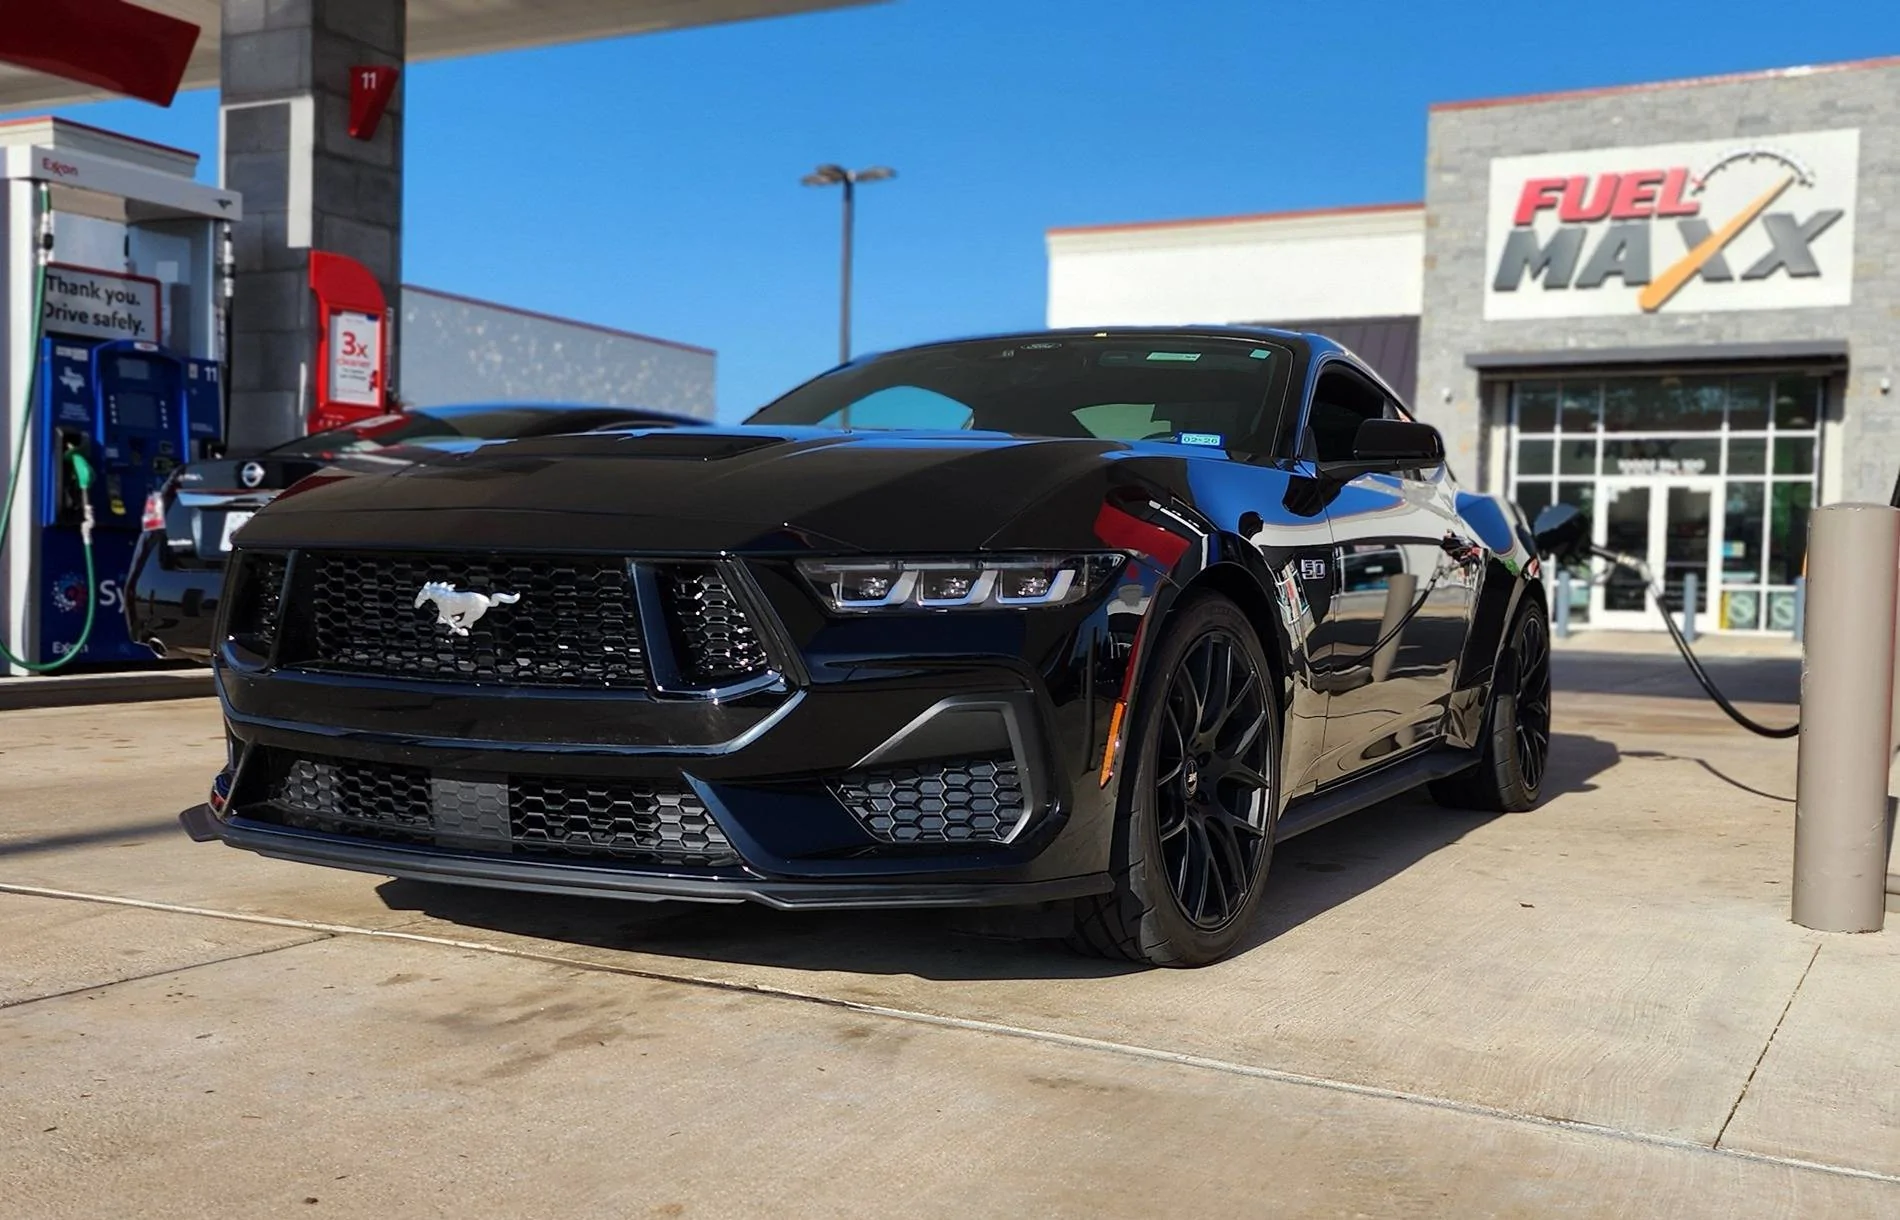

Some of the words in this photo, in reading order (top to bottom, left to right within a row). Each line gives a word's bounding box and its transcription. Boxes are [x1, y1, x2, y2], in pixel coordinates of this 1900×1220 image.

[361, 71, 377, 90] 11
[42, 156, 79, 177] Exxon
[1513, 166, 1700, 227] FUEL
[1493, 209, 1844, 311] MAXX
[46, 275, 101, 300] Thank
[104, 288, 140, 306] you.
[92, 310, 145, 336] safely.
[342, 330, 368, 358] 3x
[204, 366, 217, 382] 11
